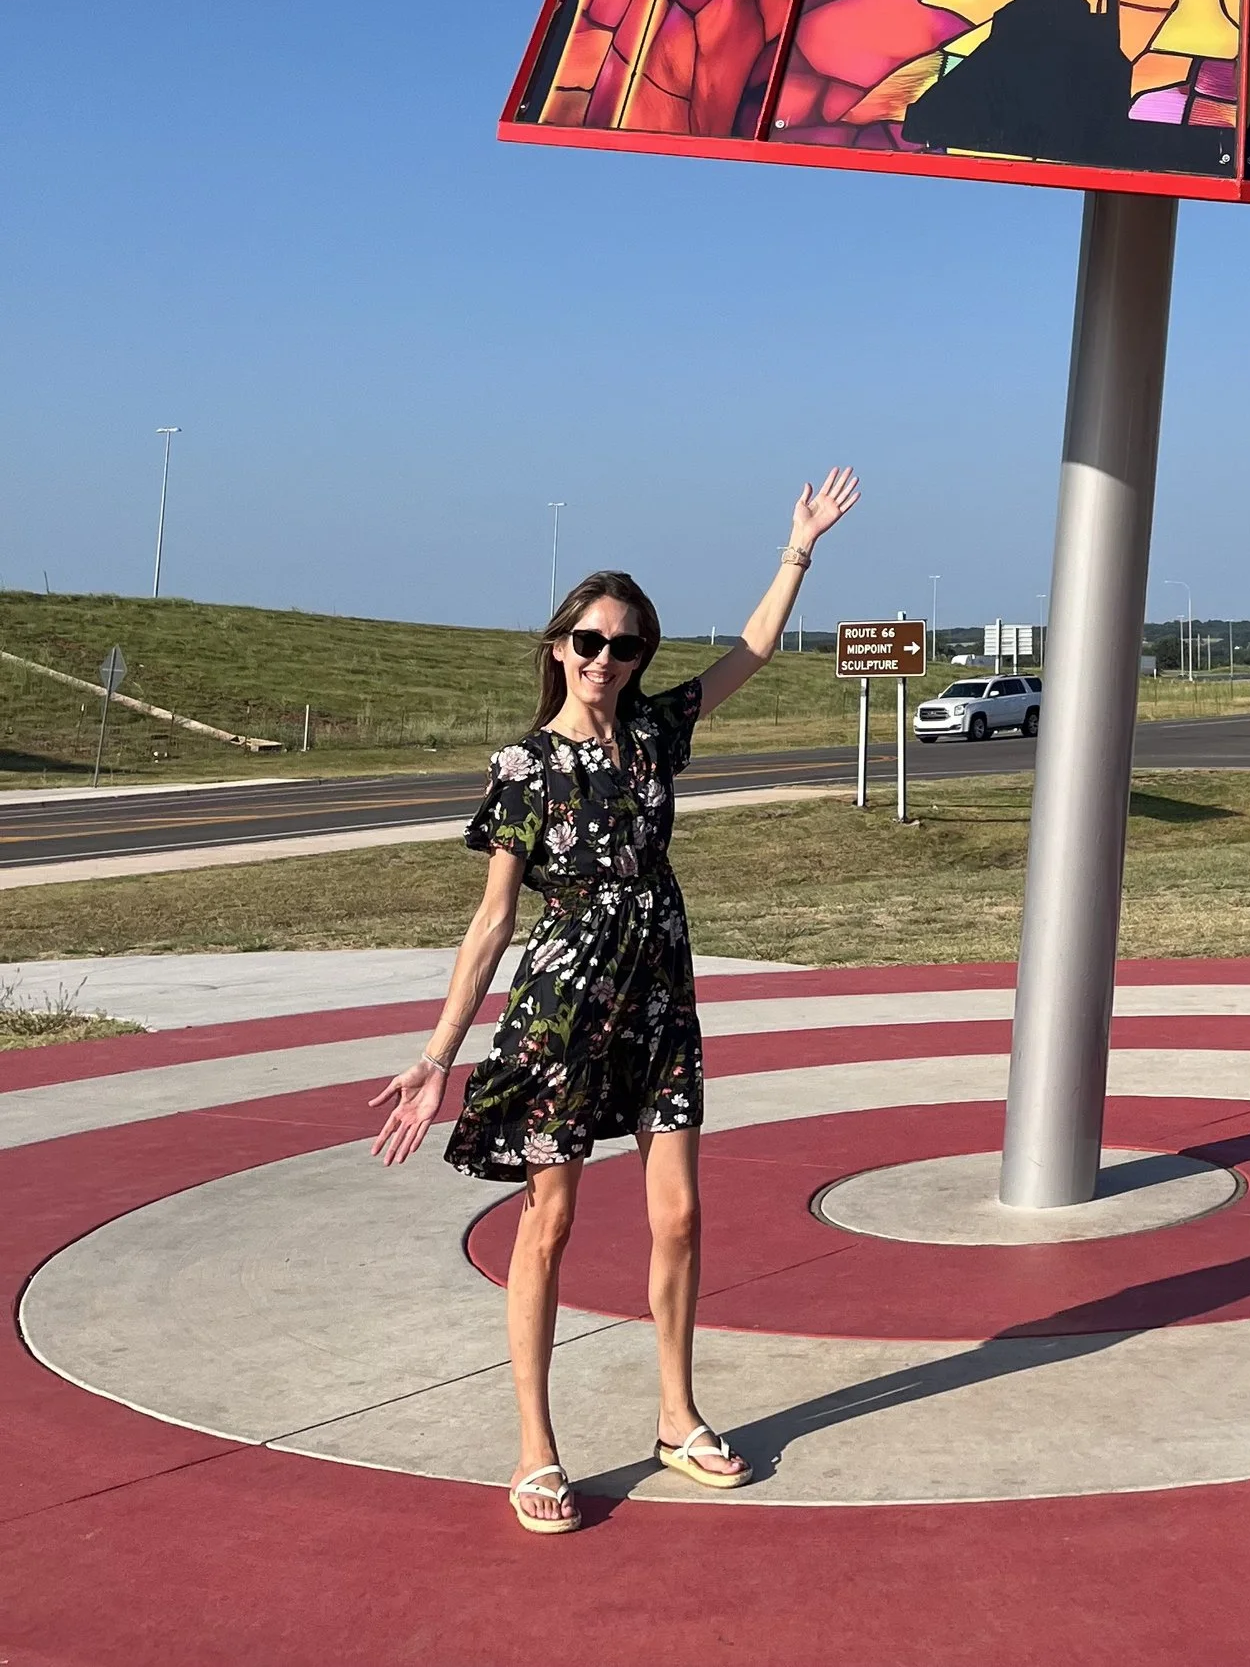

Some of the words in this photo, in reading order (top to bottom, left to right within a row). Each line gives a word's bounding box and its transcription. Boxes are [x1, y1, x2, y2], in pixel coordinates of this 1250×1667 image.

[844, 628, 877, 638] ROUTE
[881, 627, 895, 638] 66
[846, 643, 893, 655] MIDPOINT
[841, 659, 899, 671] SCULPTURE
